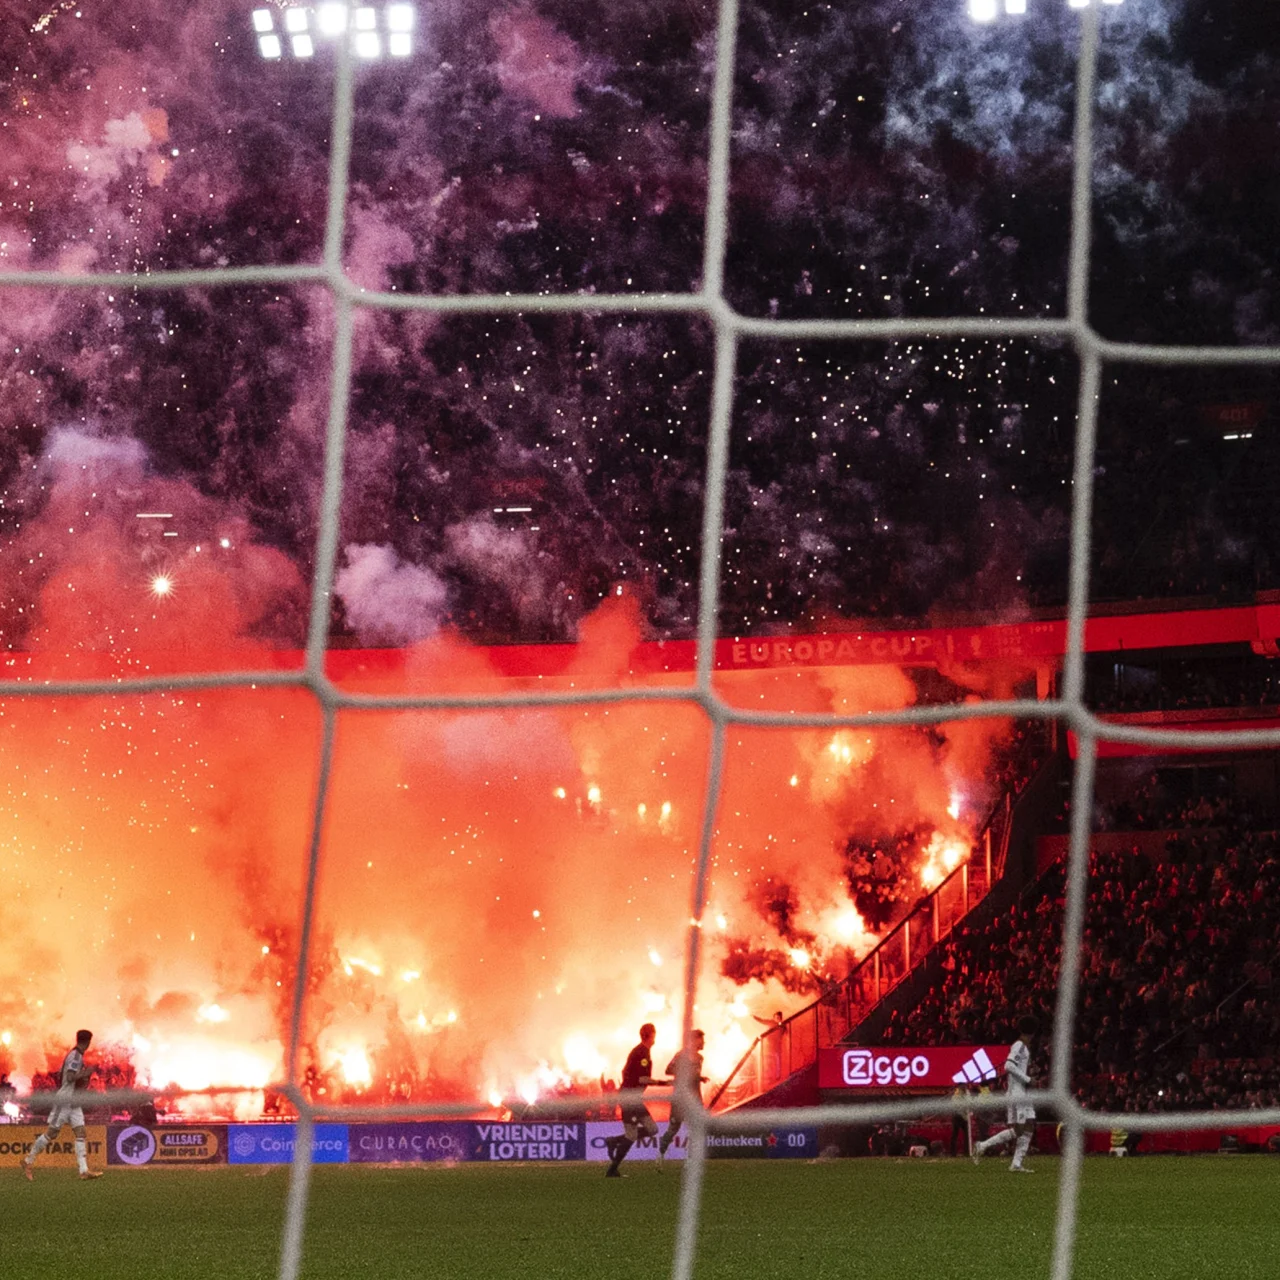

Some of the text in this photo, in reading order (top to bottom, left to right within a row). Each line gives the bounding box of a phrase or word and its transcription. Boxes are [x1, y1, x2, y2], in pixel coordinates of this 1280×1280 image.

[732, 639, 857, 663] EUROPA
[871, 635, 932, 656] CUP
[843, 1050, 929, 1085] Ziggo
[165, 1135, 203, 1145] ALLSAFE
[476, 1124, 579, 1141] VRIENDEN
[706, 1135, 763, 1147] Heineken
[260, 1137, 343, 1152] Coinerce
[359, 1135, 453, 1153] CURAÇAO
[490, 1142, 566, 1159] LOTERIJ
